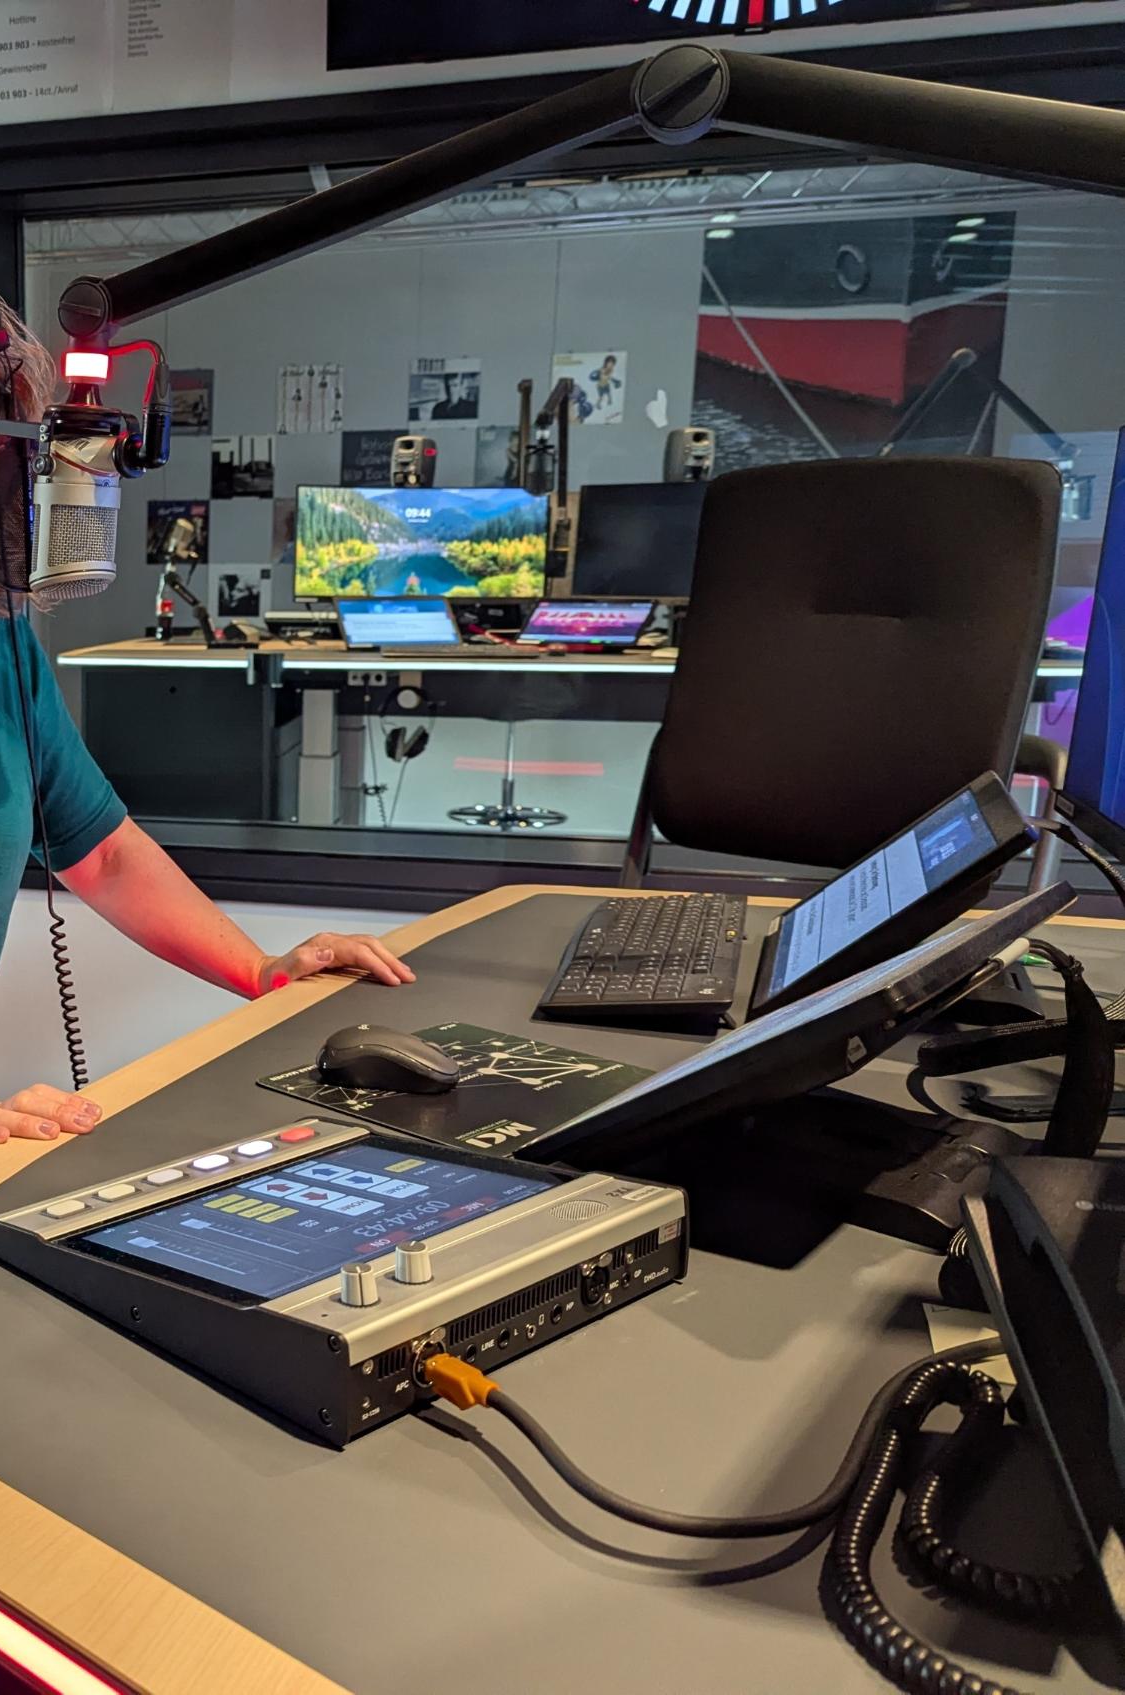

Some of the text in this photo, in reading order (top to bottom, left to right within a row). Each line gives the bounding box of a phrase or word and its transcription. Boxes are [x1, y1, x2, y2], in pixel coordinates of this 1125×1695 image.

[9, 15, 36, 25] Hotline
[15, 40, 30, 49] 903
[465, 1122, 537, 1149] MCI
[353, 1200, 451, 1237] 09:44:43
[481, 1339, 496, 1352] LINE
